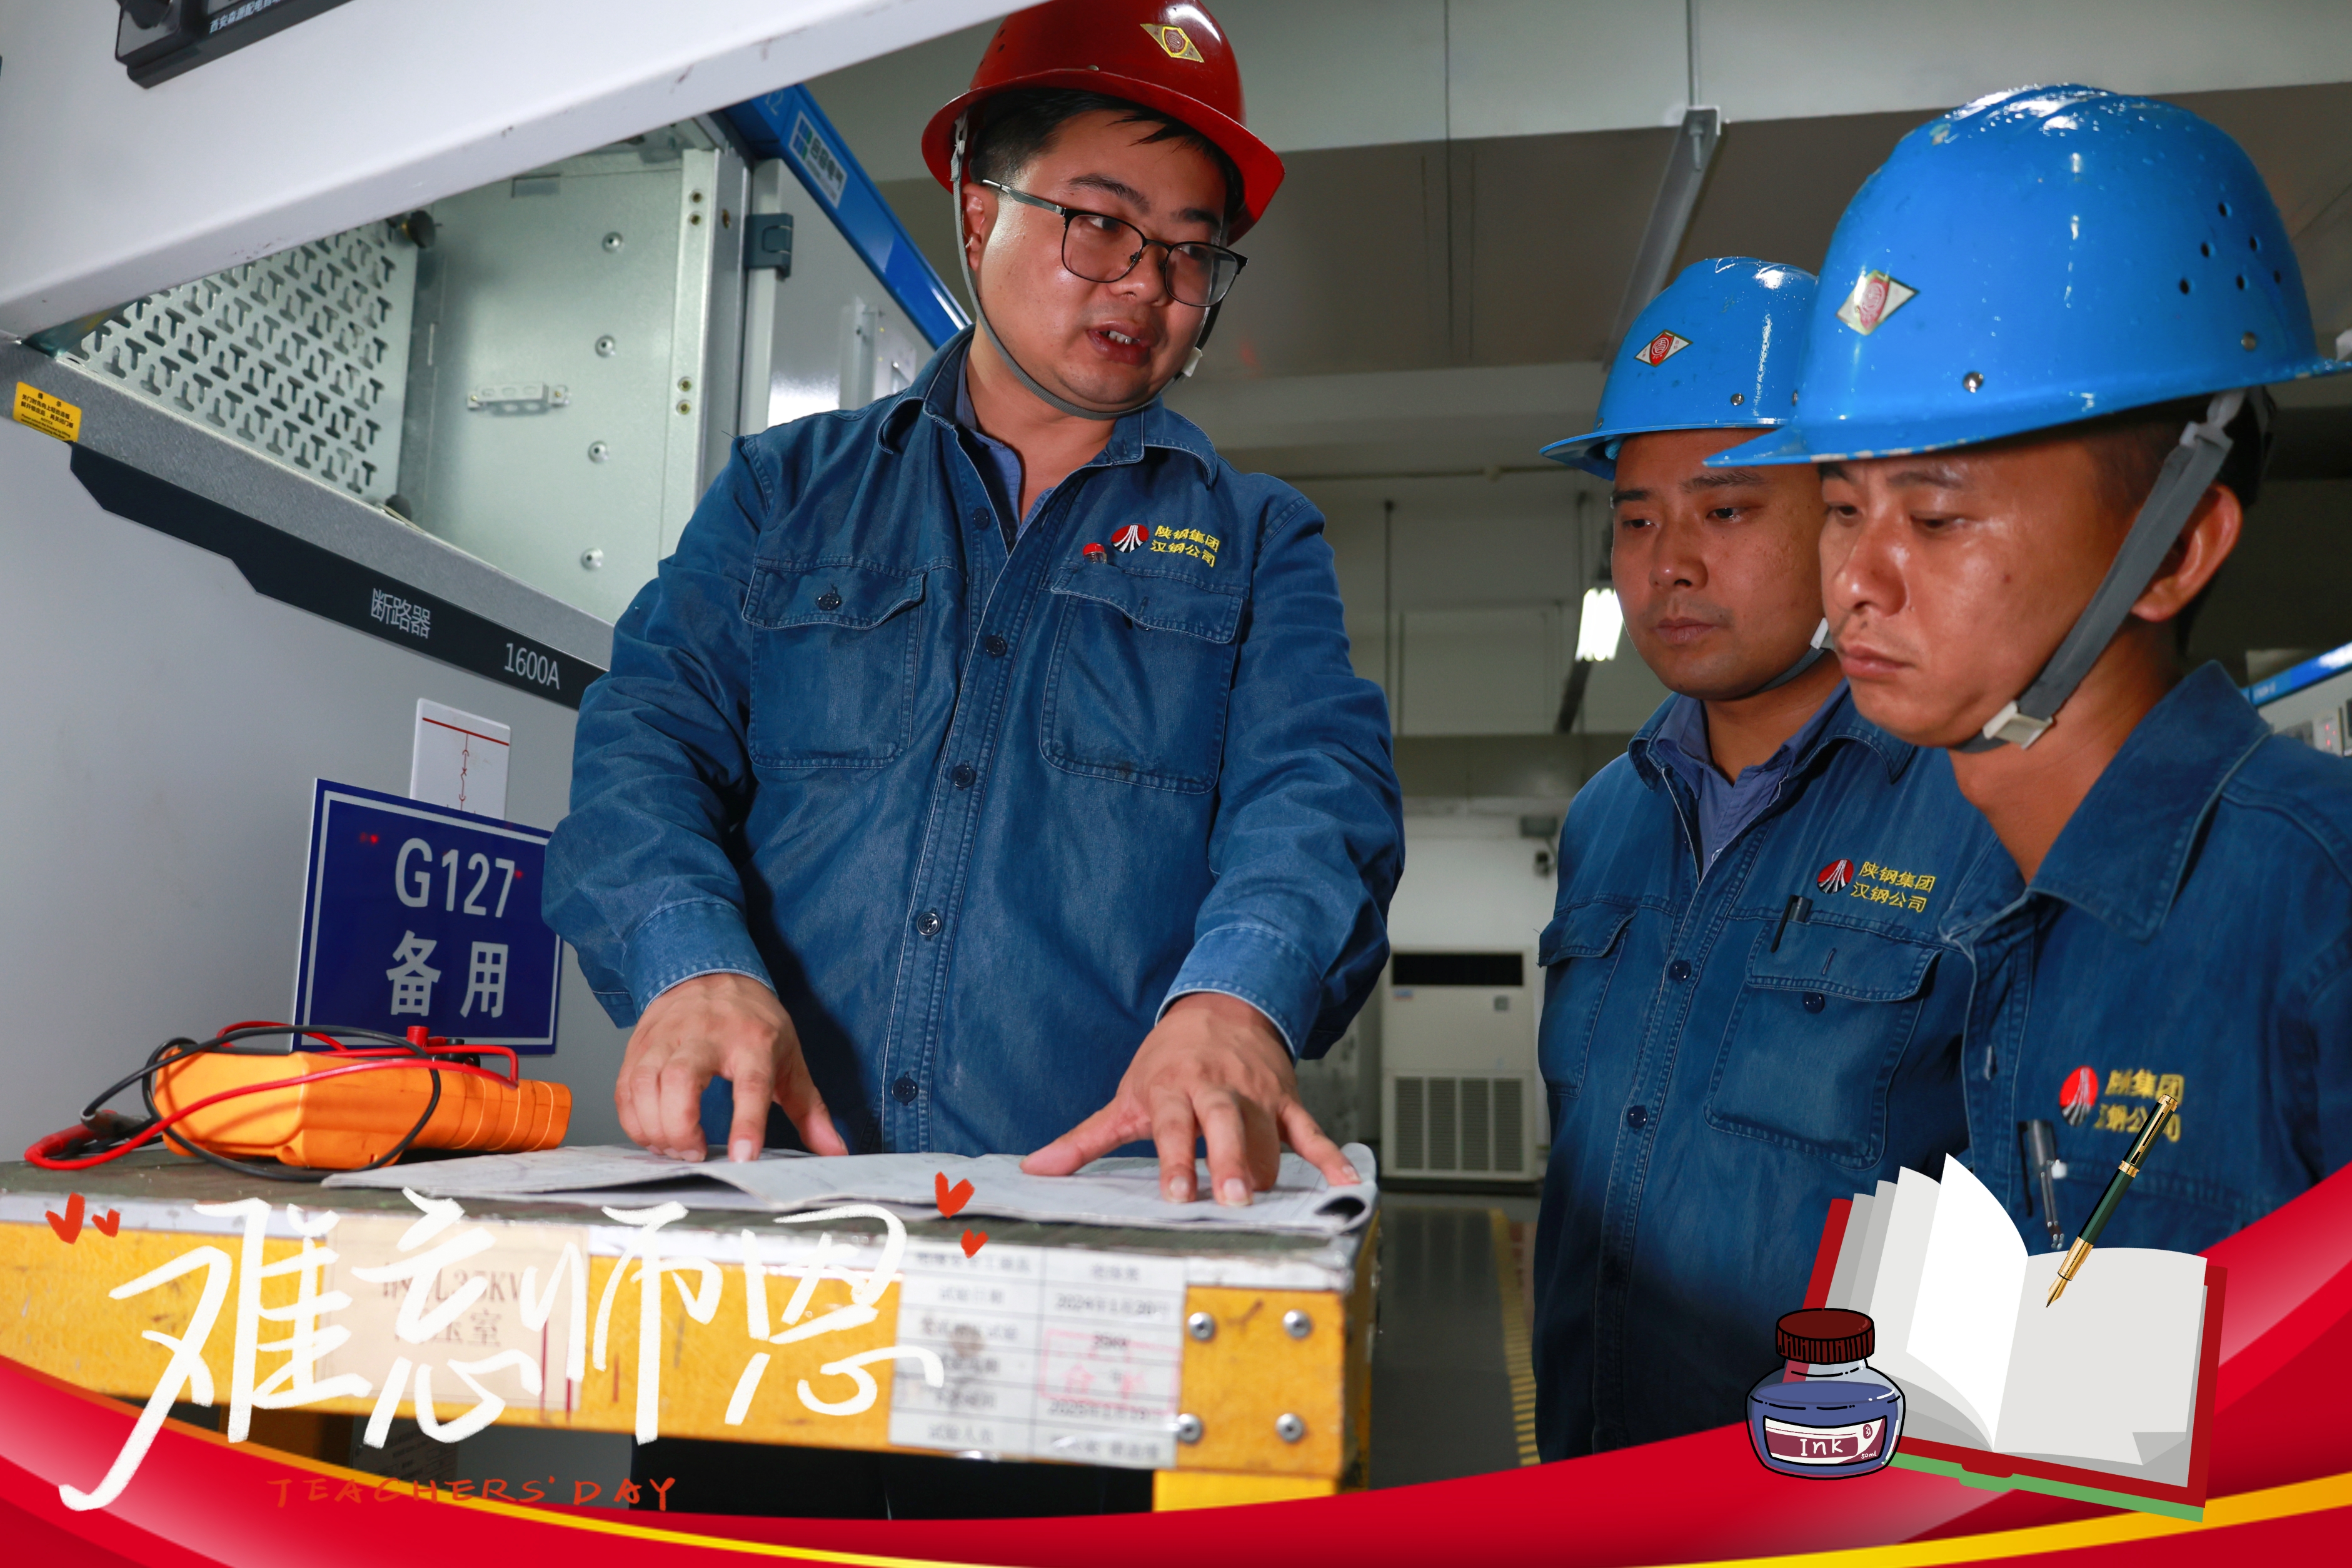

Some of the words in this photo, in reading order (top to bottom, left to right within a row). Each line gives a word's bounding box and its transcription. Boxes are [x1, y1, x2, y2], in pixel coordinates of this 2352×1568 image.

[1150, 539, 1216, 568] 汉钢公司
[1155, 525, 1220, 553] 陕钢集团
[371, 588, 431, 639] 断路器
[505, 643, 560, 690] 1600A
[395, 838, 515, 918] G127
[1859, 862, 1936, 893] 陕钢集团
[1851, 881, 1927, 913] 汉钢公司
[386, 930, 509, 1018] 备用
